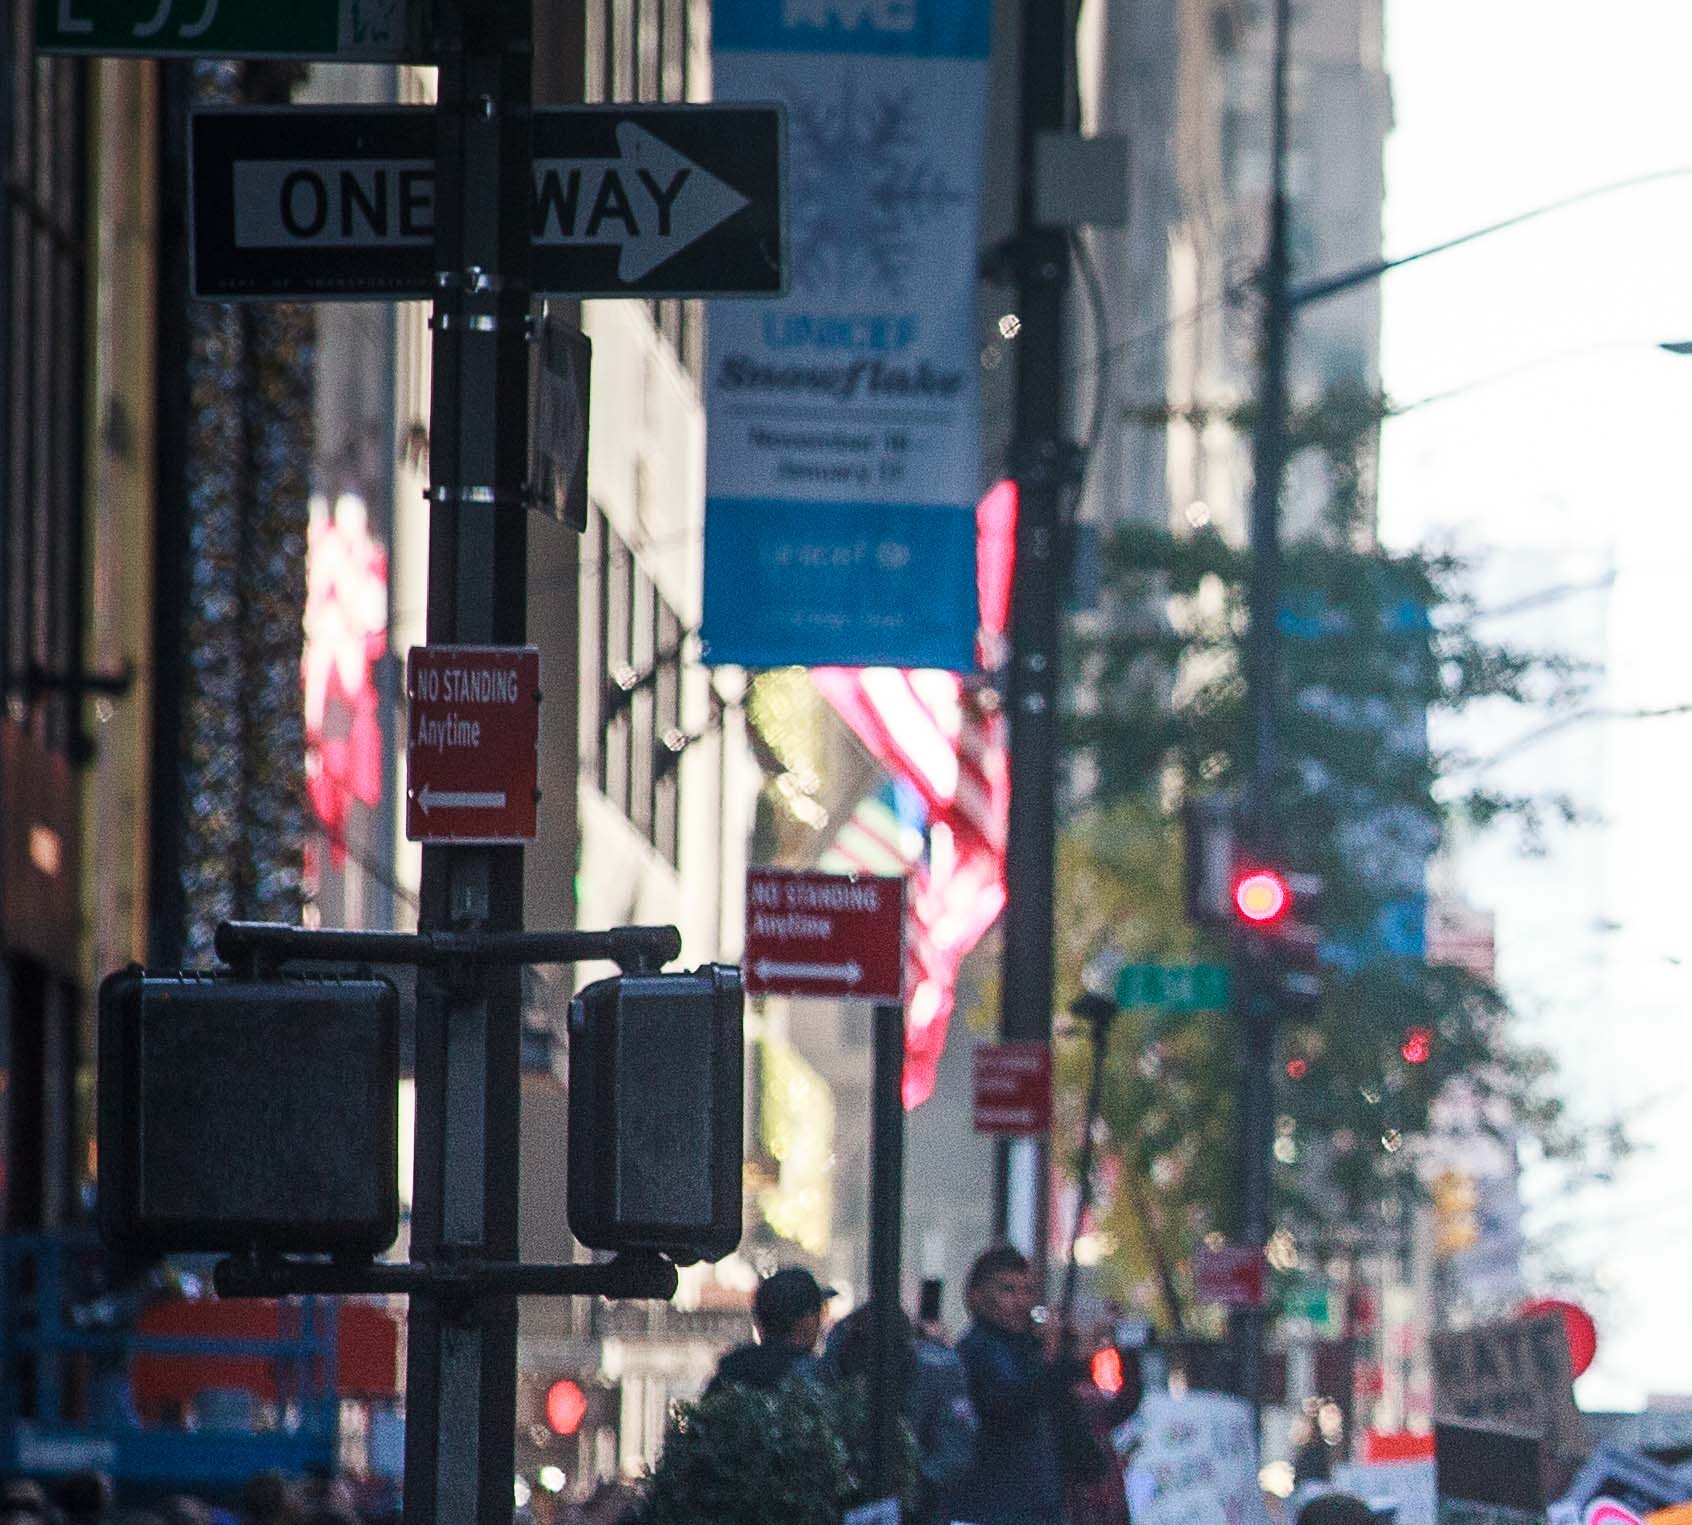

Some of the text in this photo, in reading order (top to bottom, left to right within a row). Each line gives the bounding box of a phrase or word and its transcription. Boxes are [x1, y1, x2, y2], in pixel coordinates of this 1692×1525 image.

[279, 167, 693, 239] ONE WAY
[418, 669, 518, 704] NO STANDING
[419, 712, 480, 754] Anytime
[752, 880, 881, 912] NO STANDING
